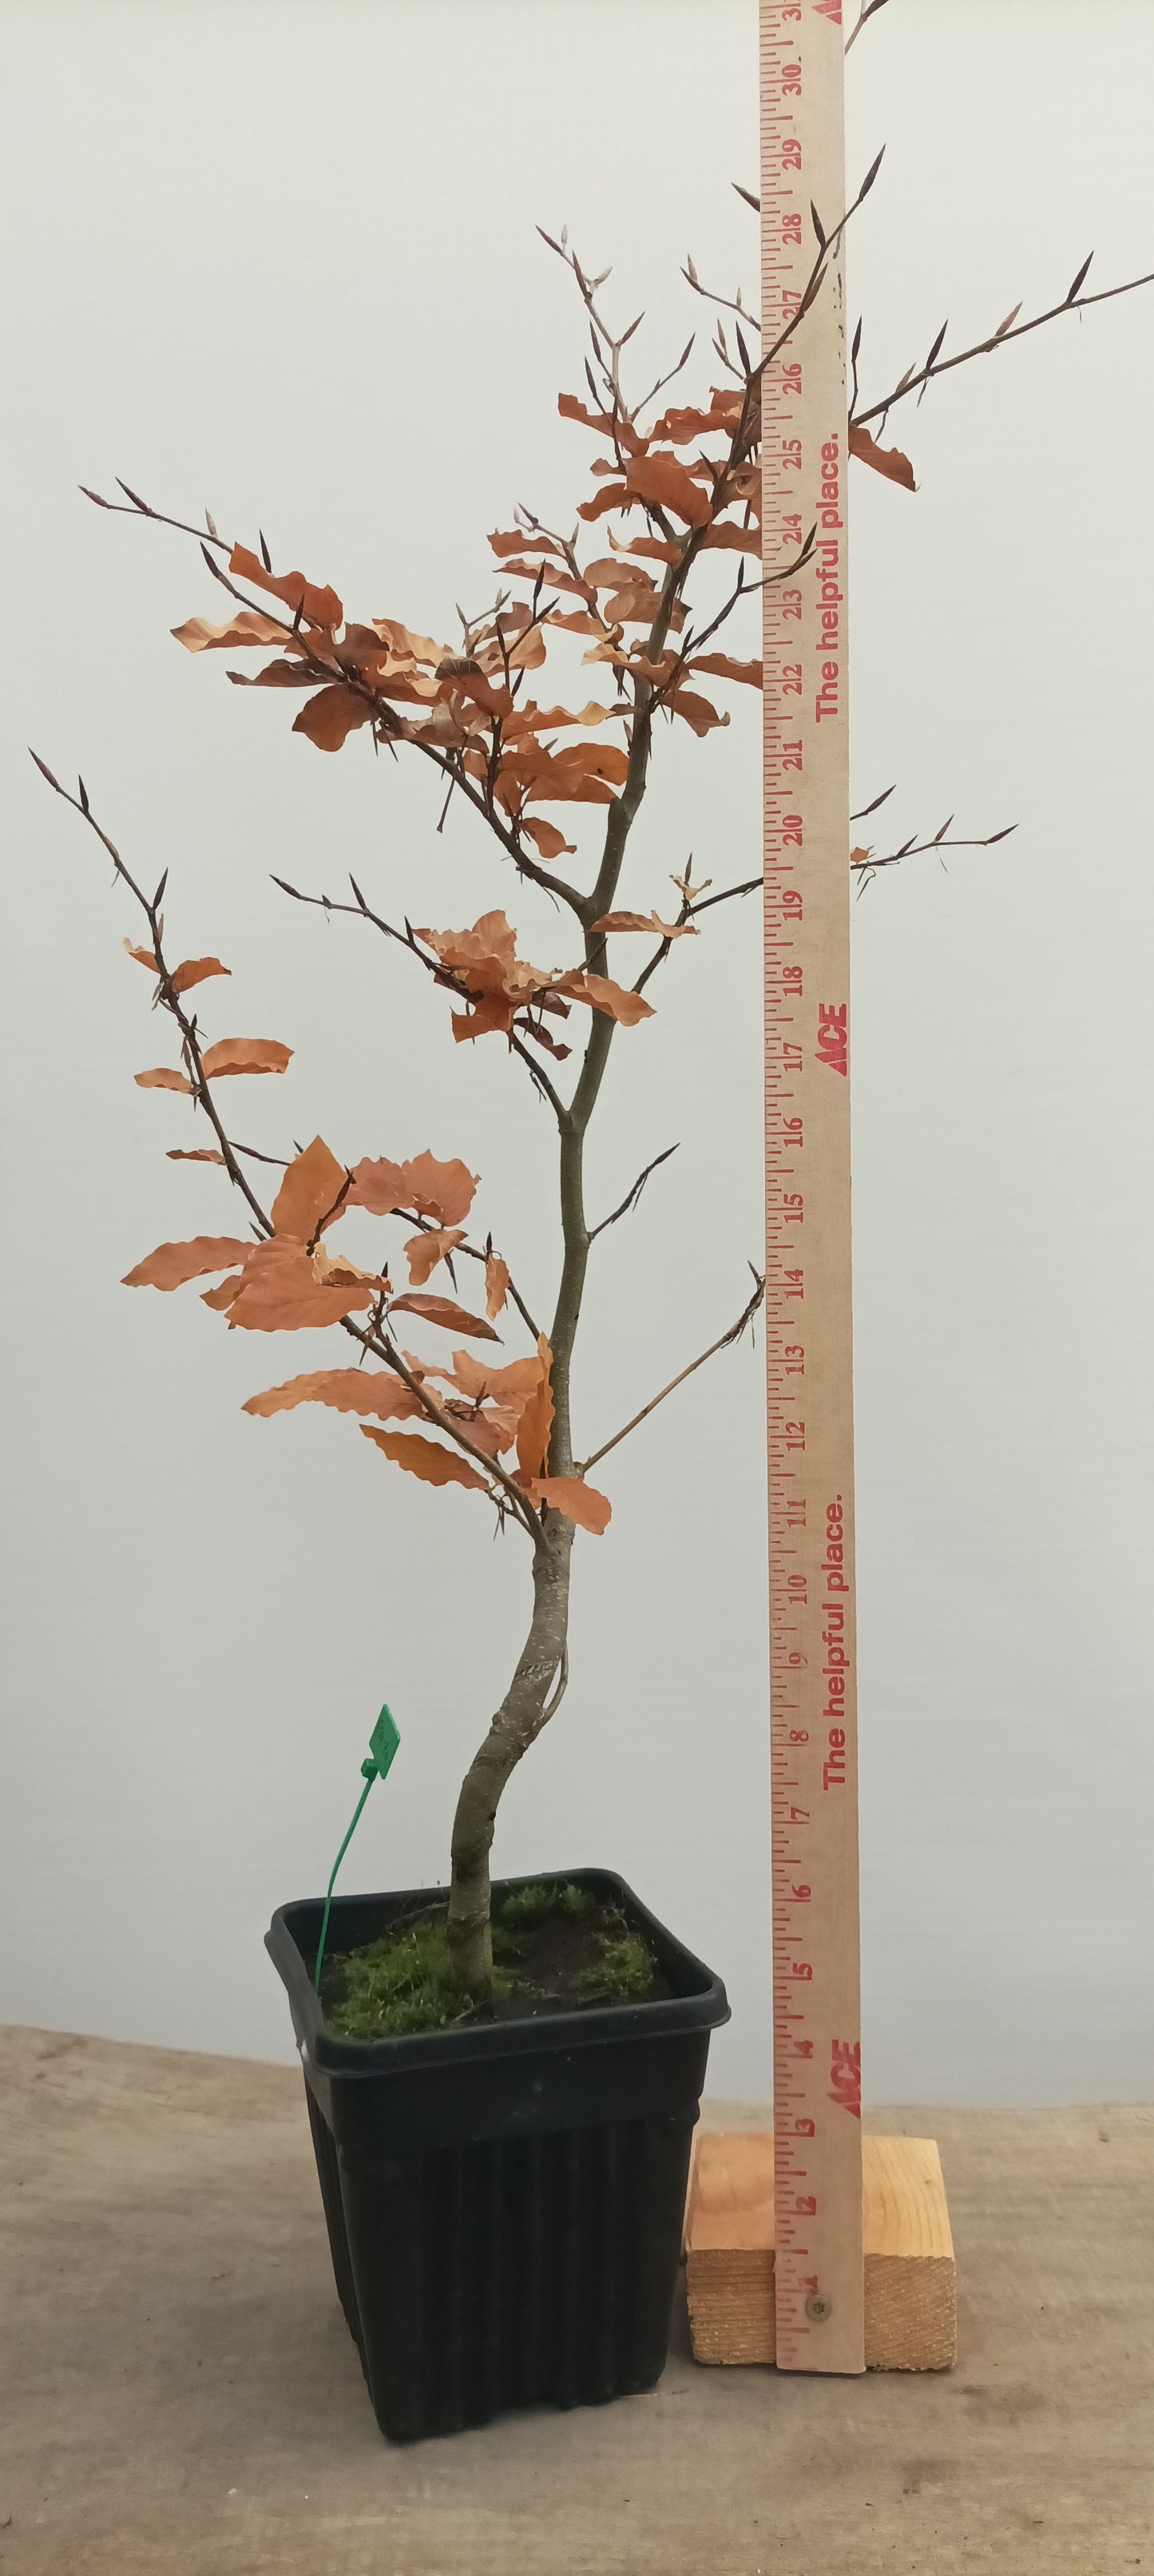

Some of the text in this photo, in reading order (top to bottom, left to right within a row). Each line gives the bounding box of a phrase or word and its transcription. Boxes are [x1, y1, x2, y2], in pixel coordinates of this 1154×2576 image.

[782, 0, 802, 21] 3
[782, 64, 802, 96] 30
[782, 138, 802, 171] 29
[782, 212, 802, 245] 28
[782, 289, 802, 320] 27
[782, 363, 802, 395] 26
[782, 438, 803, 470] 25
[782, 513, 803, 546] 24
[815, 433, 844, 724] The helpful place.
[782, 588, 803, 620] 23
[782, 663, 803, 697] 22
[782, 740, 803, 772] 21
[782, 814, 803, 847] 20
[783, 891, 803, 922] 19
[783, 966, 803, 998] 18
[815, 1002, 848, 1078] ACE
[783, 1042, 803, 1072] 17
[783, 1117, 804, 1149] 16
[783, 1193, 804, 1224] 15
[784, 1268, 804, 1300] 14
[785, 1344, 805, 1375] 13
[785, 1421, 806, 1451] 12
[786, 1501, 807, 1527] 11
[787, 1574, 807, 1605] 10
[787, 1651, 807, 1665] 9
[821, 1494, 851, 1792] The helpful place.
[789, 1729, 809, 1743] 8
[789, 1807, 810, 1821] 7
[791, 1884, 811, 1899] 6
[791, 1962, 813, 1980] 5
[794, 2040, 814, 2058] 4
[827, 2038, 861, 2120] ACE
[794, 2118, 816, 2136] 3
[795, 2197, 817, 2217] 2
